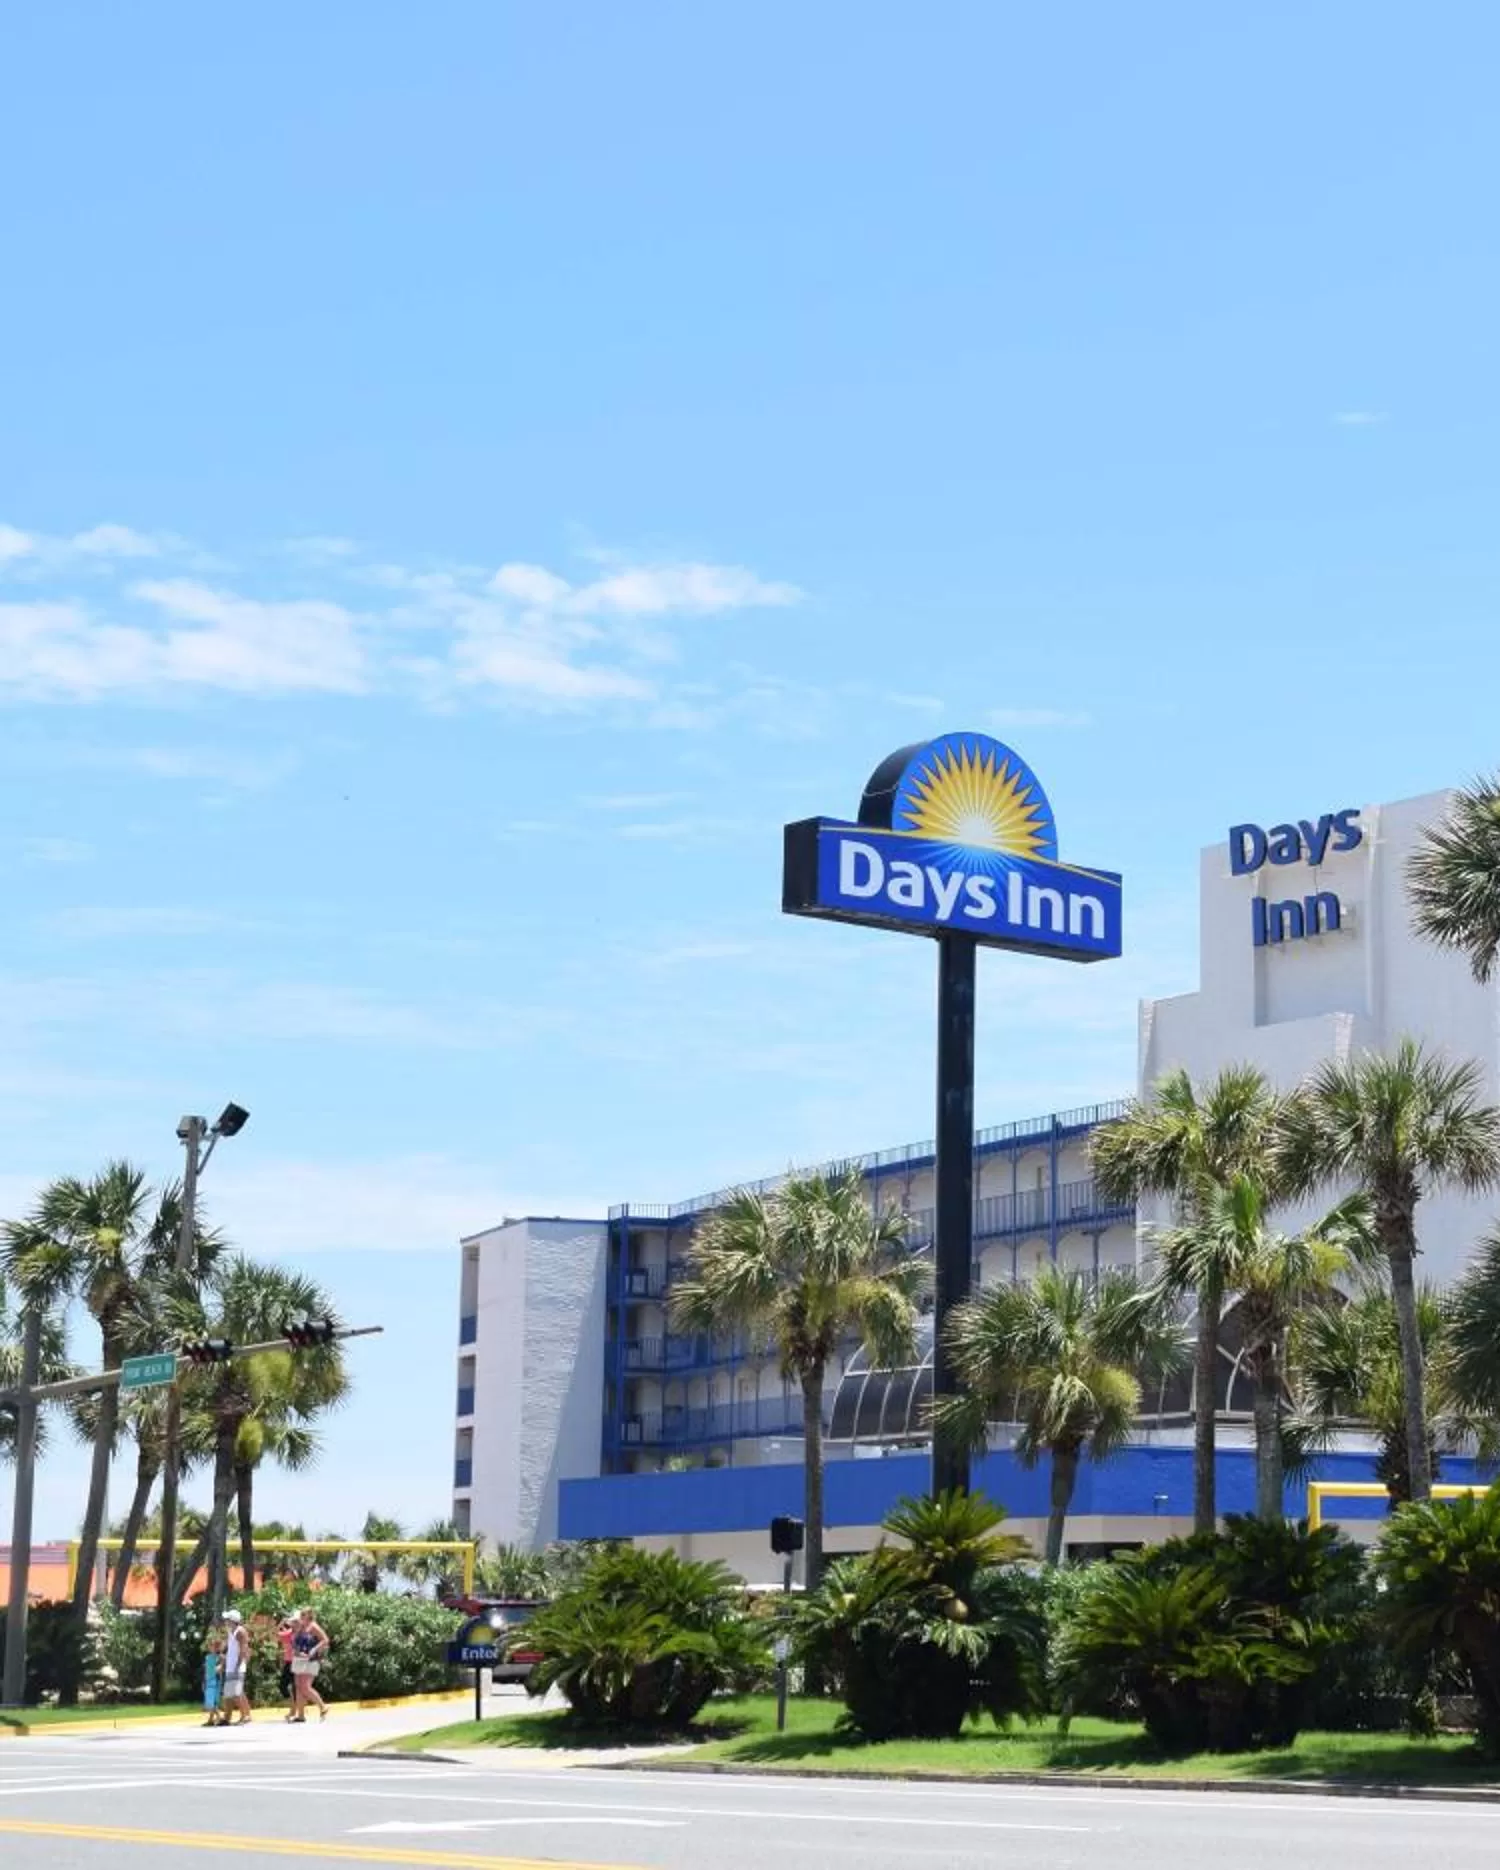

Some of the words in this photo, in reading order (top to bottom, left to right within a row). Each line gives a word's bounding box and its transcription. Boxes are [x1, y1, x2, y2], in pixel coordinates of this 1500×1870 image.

[1229, 809, 1363, 876] Days
[839, 839, 997, 921] Days
[1007, 871, 1105, 939] Inn
[1251, 891, 1341, 946] Inn
